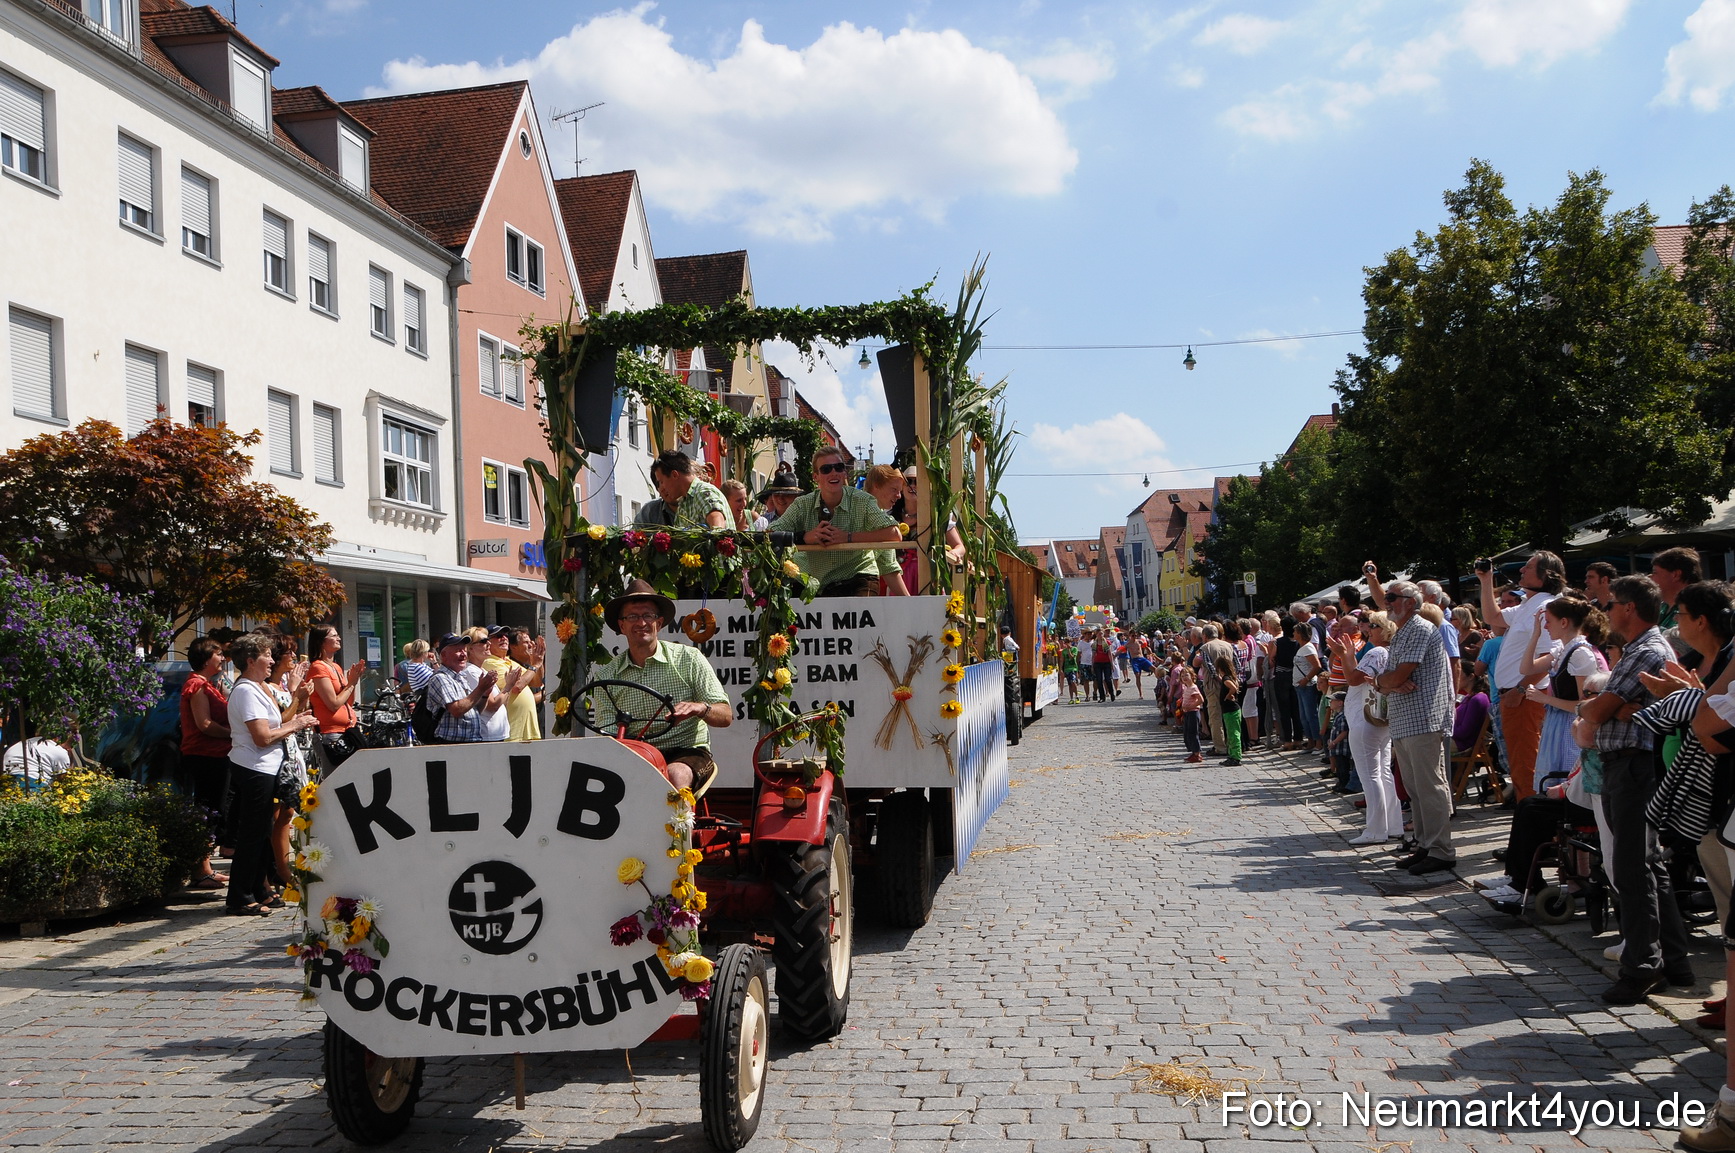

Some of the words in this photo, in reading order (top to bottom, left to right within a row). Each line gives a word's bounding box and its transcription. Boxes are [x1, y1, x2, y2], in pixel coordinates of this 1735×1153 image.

[832, 610, 875, 629] MIA
[793, 637, 853, 656] TIER
[807, 664, 858, 683] BAM
[335, 755, 626, 855] KLJB
[463, 923, 503, 942] KLJB
[304, 948, 686, 1037] RÖCKERSBÜHL
